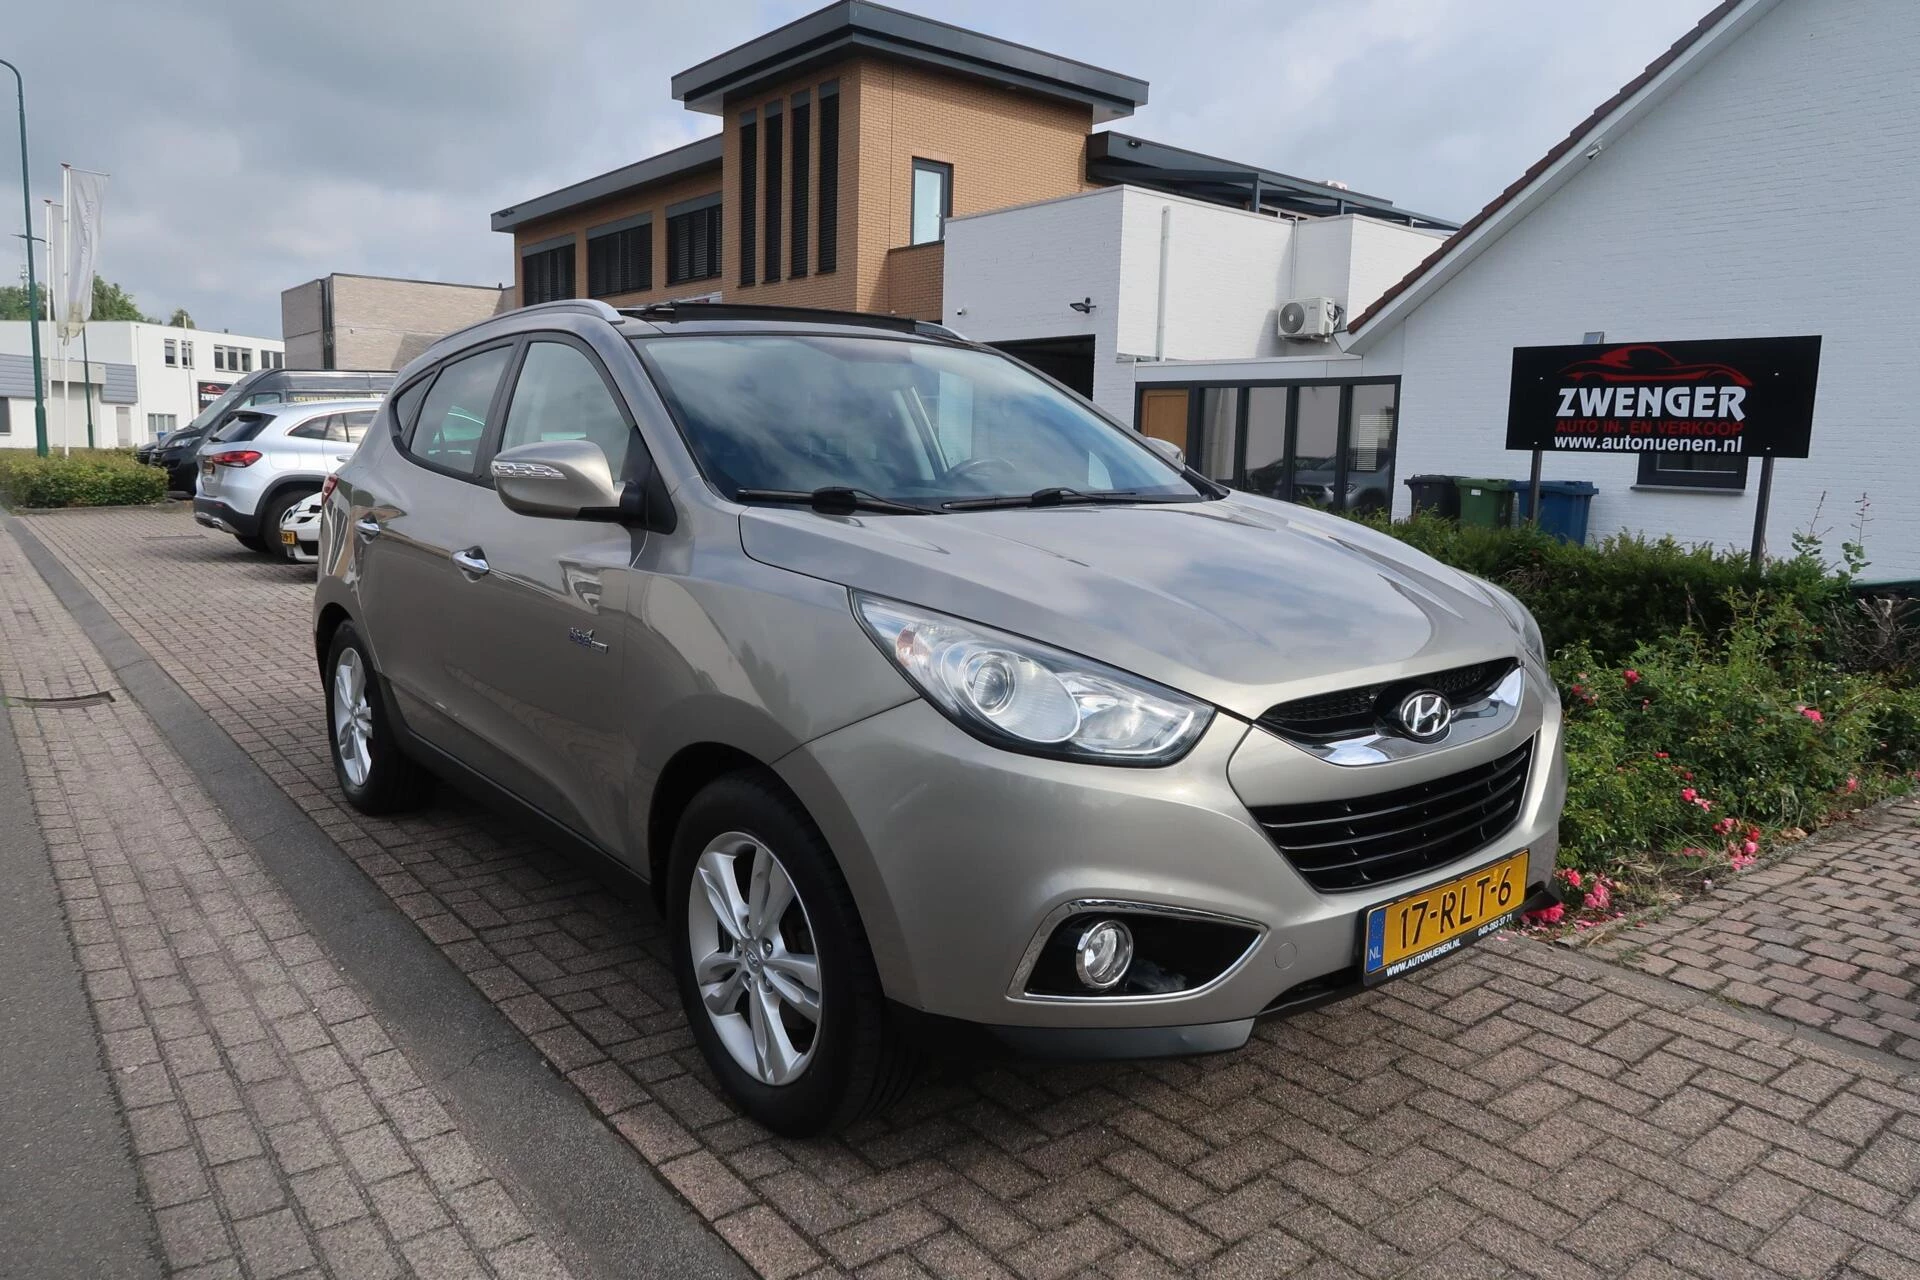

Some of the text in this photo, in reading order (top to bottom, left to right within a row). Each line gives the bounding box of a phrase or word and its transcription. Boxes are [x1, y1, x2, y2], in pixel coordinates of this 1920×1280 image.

[1556, 386, 1746, 421] ZWENGER
[1556, 420, 1744, 436] AUTO IN- EN VERKOOP
[1554, 435, 1743, 453] www.autonuenen.nl
[1401, 865, 1512, 949] 17-RLT-6
[1369, 946, 1381, 961] NL
[1386, 938, 1461, 977] WWW.AUTONUENEN.NL
